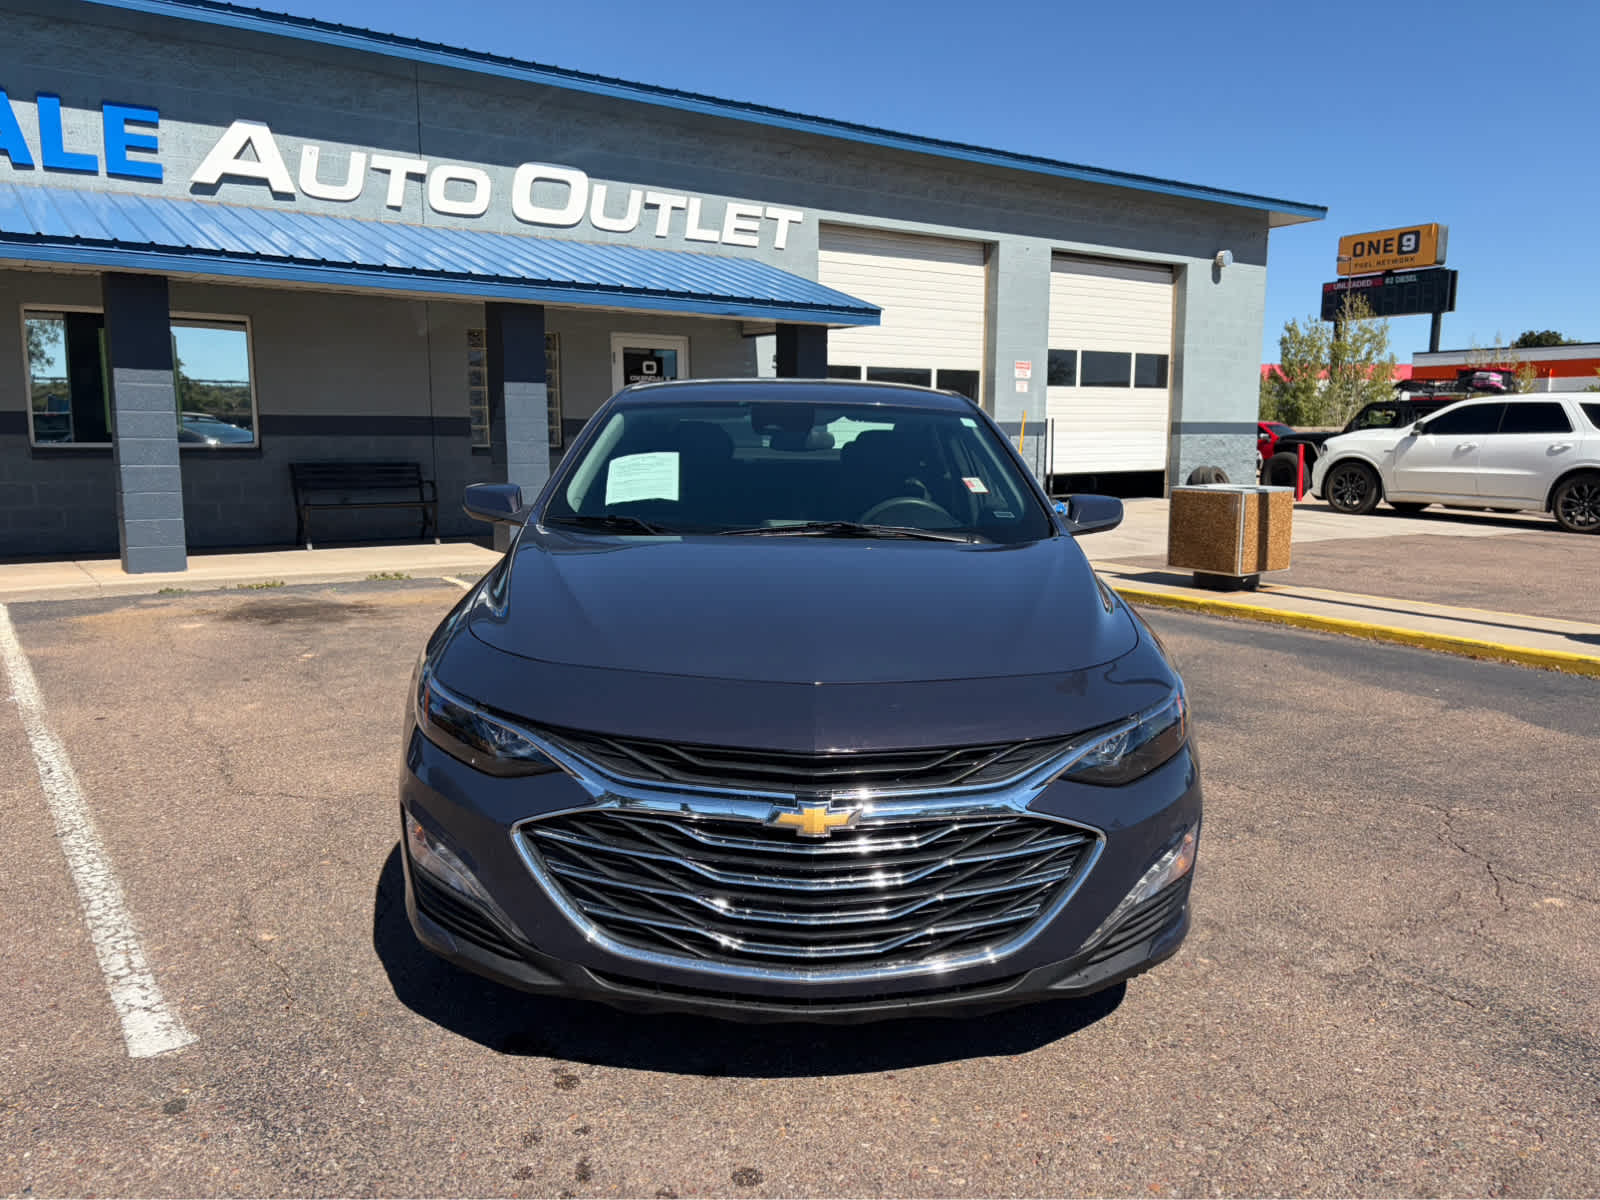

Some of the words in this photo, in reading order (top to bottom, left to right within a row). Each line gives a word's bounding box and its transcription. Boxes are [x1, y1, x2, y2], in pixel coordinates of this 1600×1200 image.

[191, 119, 491, 216] AUTO
[512, 161, 803, 249] OUTLET
[1353, 239, 1394, 257] ONE
[1401, 234, 1416, 251] 9
[1376, 254, 1416, 267] NETWORK
